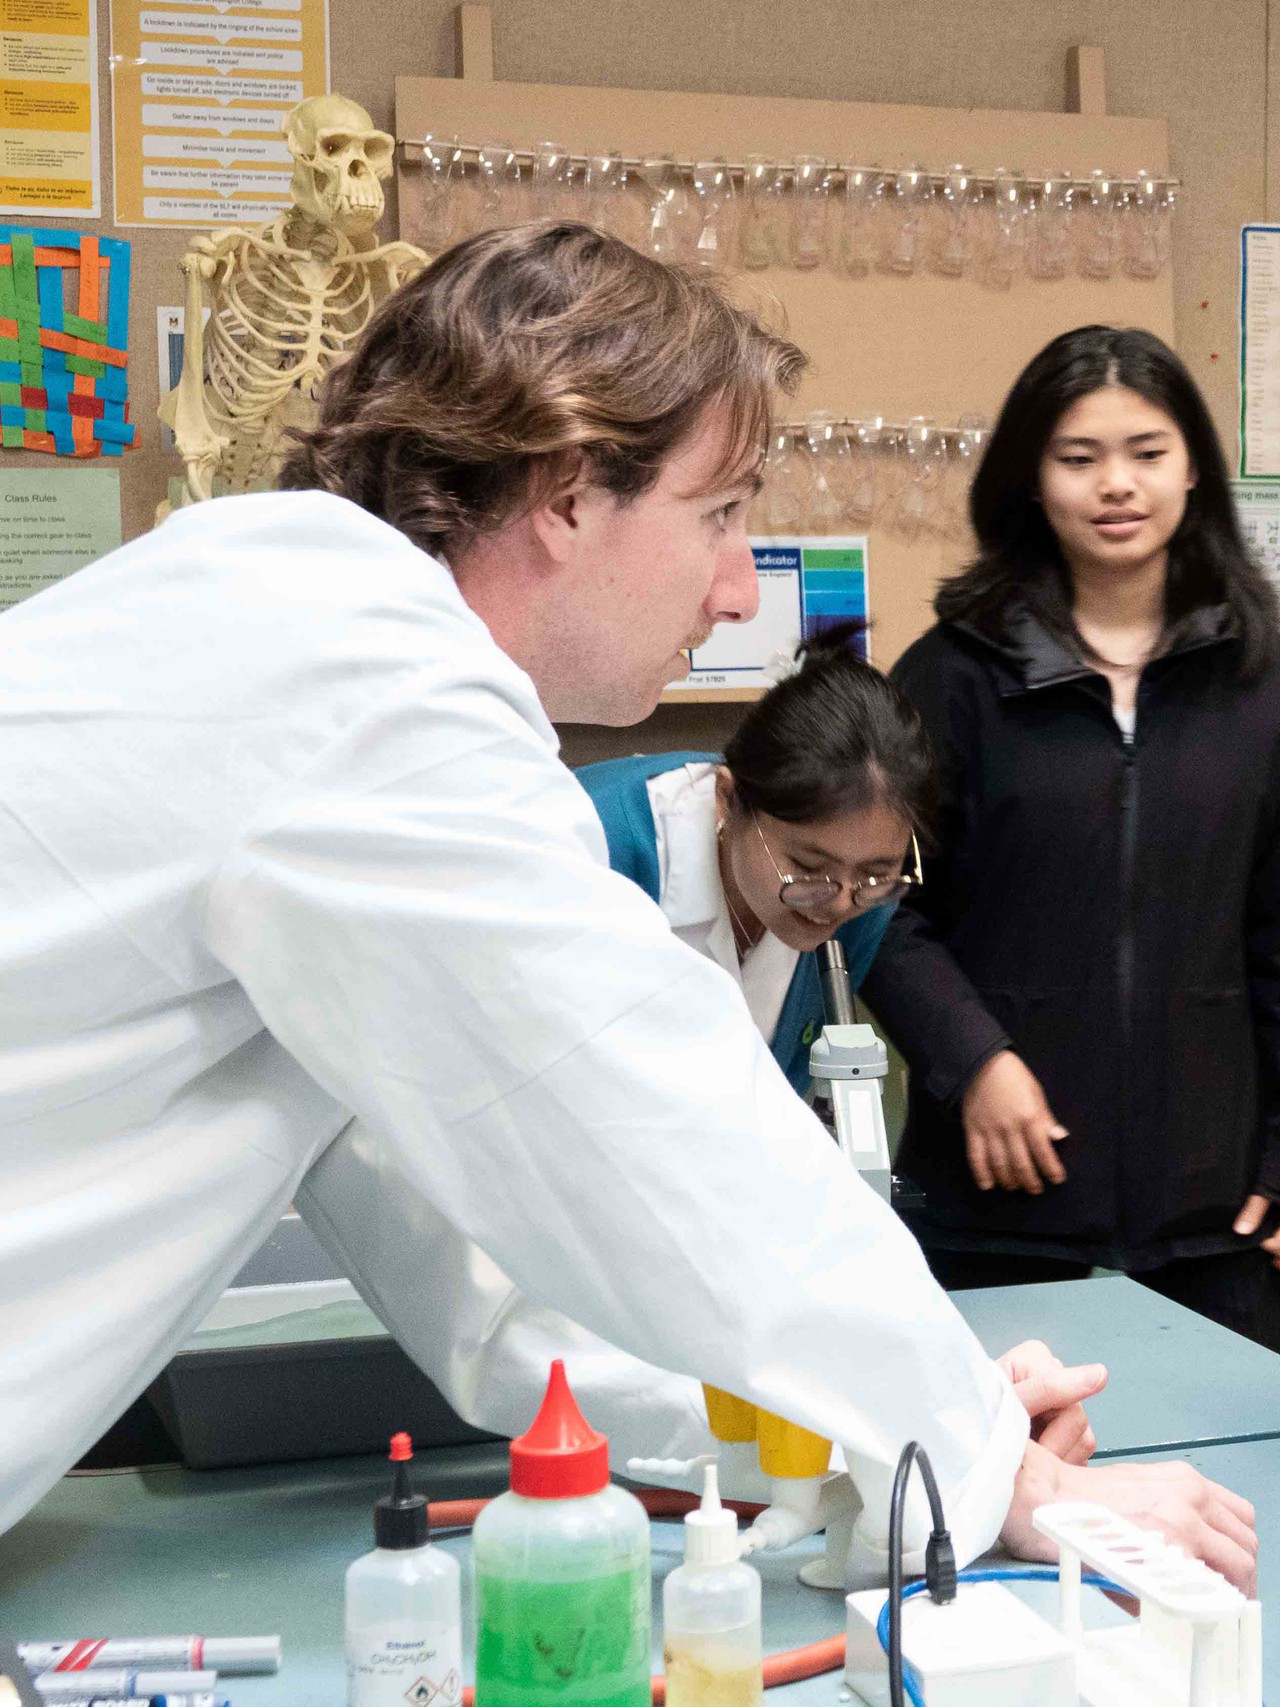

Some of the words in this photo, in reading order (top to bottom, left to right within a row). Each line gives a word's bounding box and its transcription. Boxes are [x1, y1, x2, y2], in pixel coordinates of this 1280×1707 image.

[184, 20, 208, 28] indicated
[229, 23, 248, 32] ringing
[161, 47, 188, 55] Lockdown
[190, 48, 220, 56] procedures
[267, 52, 283, 60] police
[156, 86, 171, 94] lights
[213, 88, 240, 96] electronic
[208, 114, 221, 122] from
[222, 115, 246, 123] windows
[182, 144, 208, 152] Minimise
[159, 201, 173, 209] Only
[242, 204, 268, 212] physically
[5, 494, 30, 503] Class
[32, 494, 57, 503] Rules
[386, 1640, 426, 1650] Ethanol
